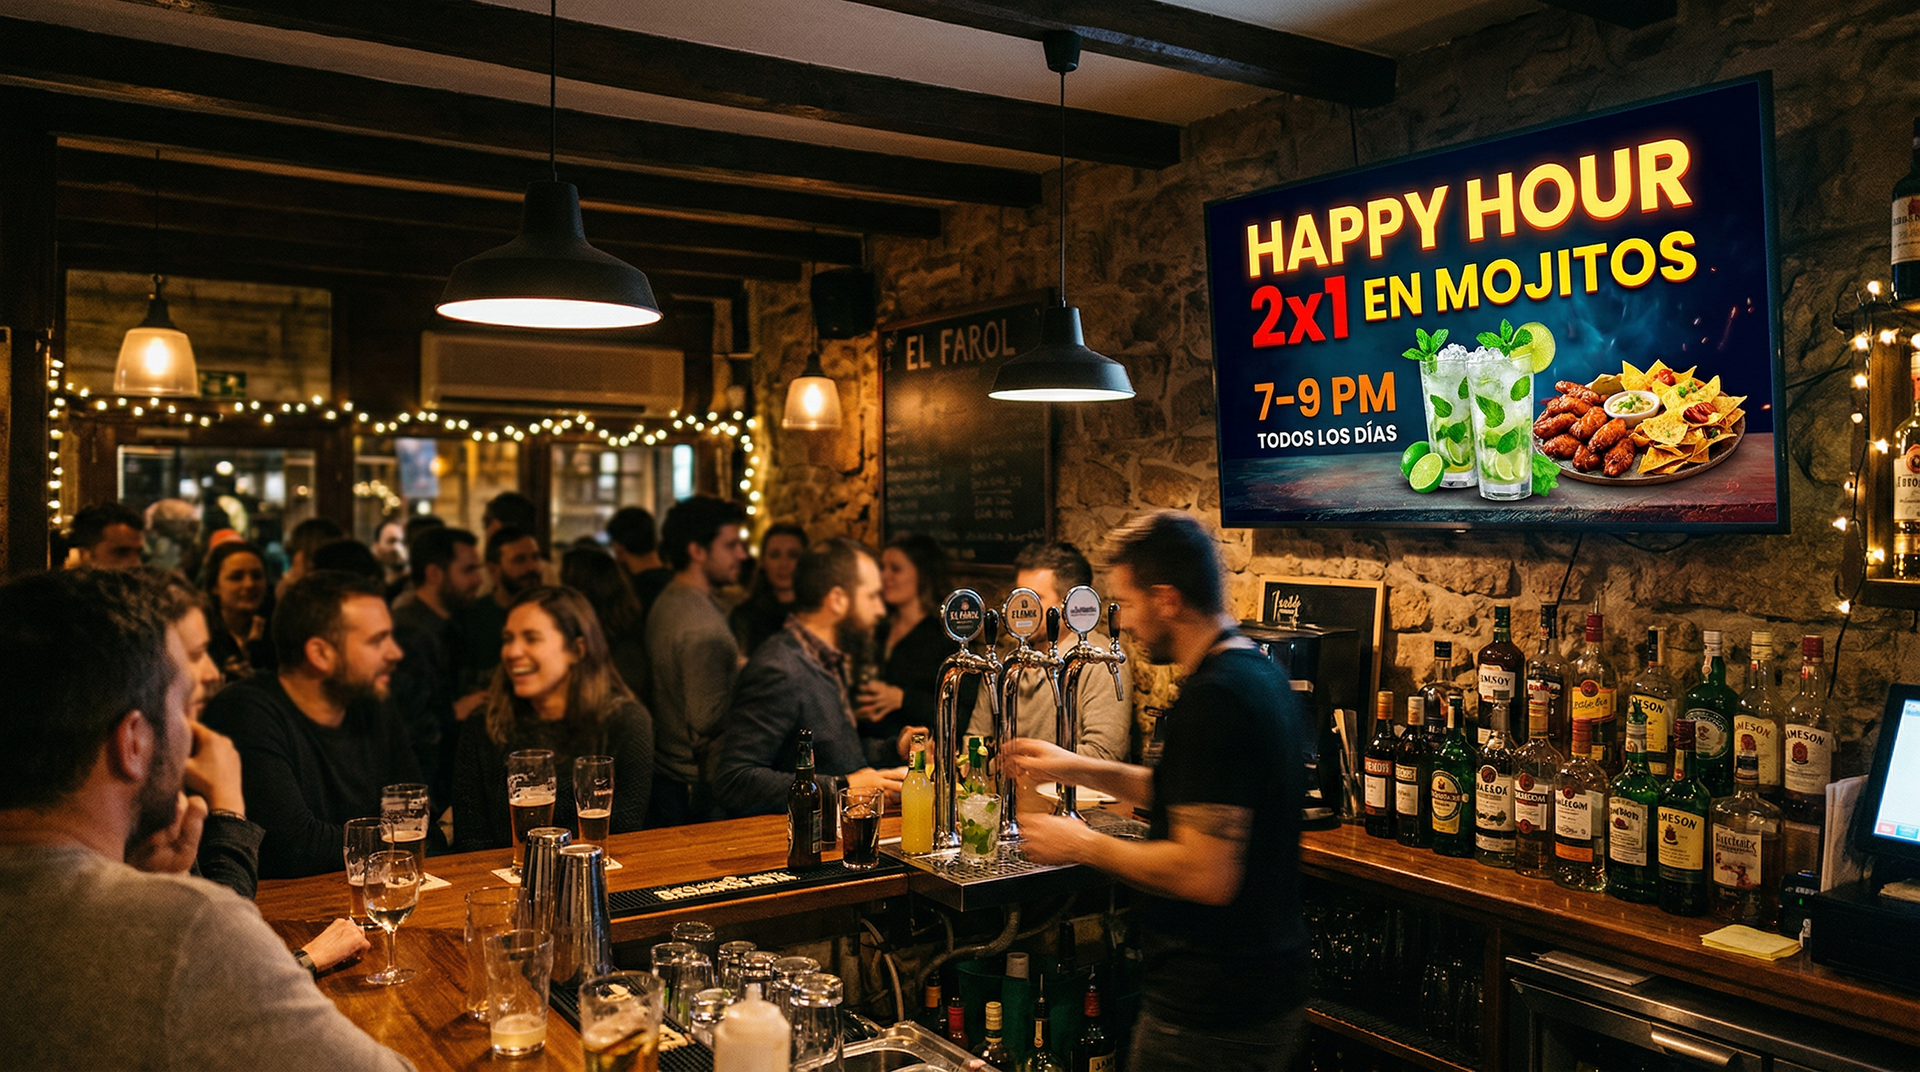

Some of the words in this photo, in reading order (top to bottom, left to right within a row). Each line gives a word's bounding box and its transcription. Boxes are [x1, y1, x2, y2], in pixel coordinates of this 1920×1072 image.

[1247, 186, 1449, 278] HAPPY
[1466, 139, 1694, 242] HOUR
[1251, 275, 1350, 348] 2x1
[1364, 272, 1423, 322] EN
[1436, 231, 1698, 312] MOJITOS
[906, 335, 932, 371] EL
[940, 318, 1016, 366] FAROL
[1331, 371, 1396, 415] PM
[1257, 429, 1314, 449] TODOS
[1317, 428, 1351, 446] LOS
[1354, 420, 1398, 444] DÍAS
